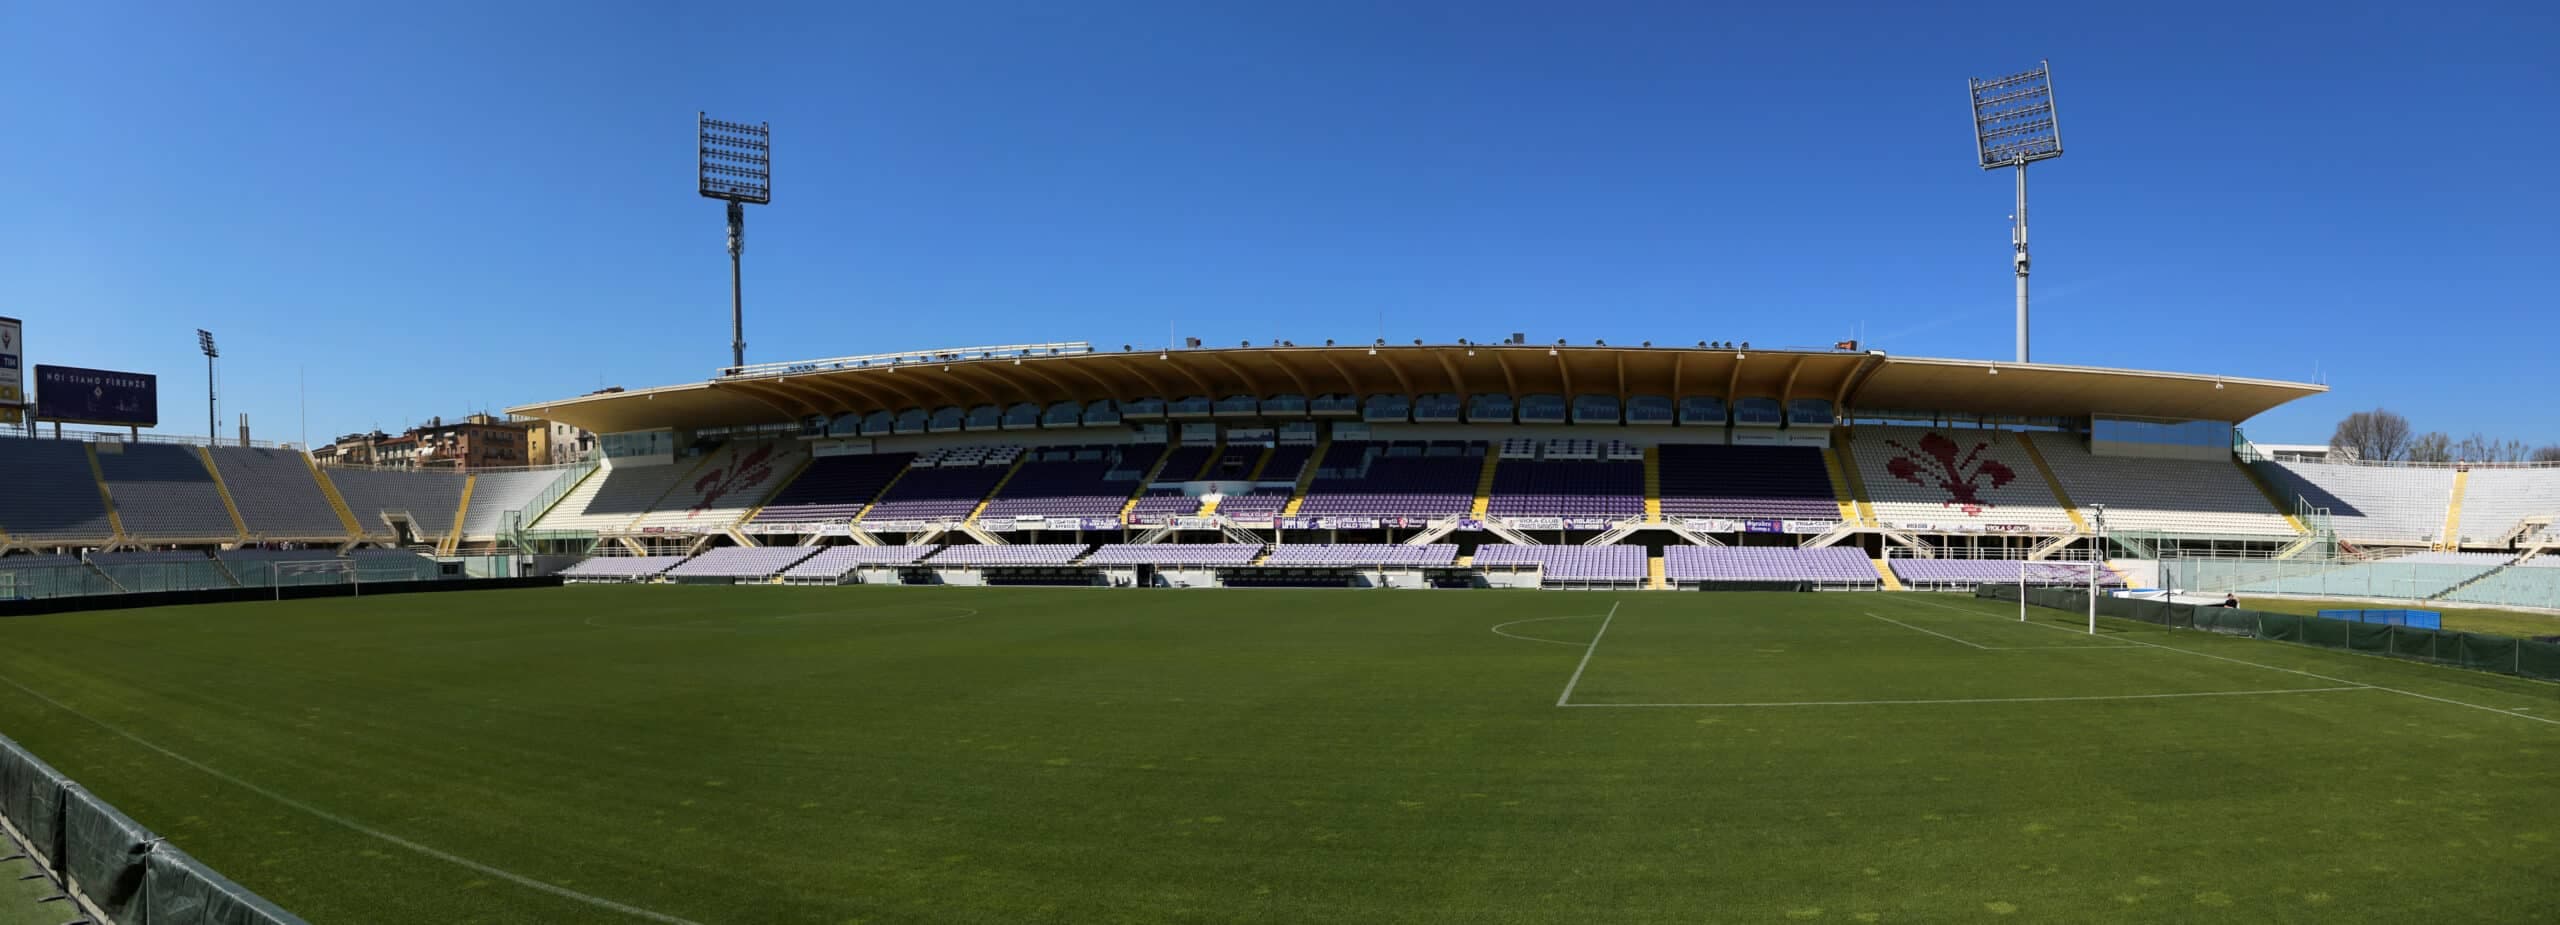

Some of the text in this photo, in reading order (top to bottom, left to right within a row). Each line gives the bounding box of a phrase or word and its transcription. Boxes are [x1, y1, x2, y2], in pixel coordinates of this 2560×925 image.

[46, 373, 146, 389] NOI SIAMO FIRENZE
